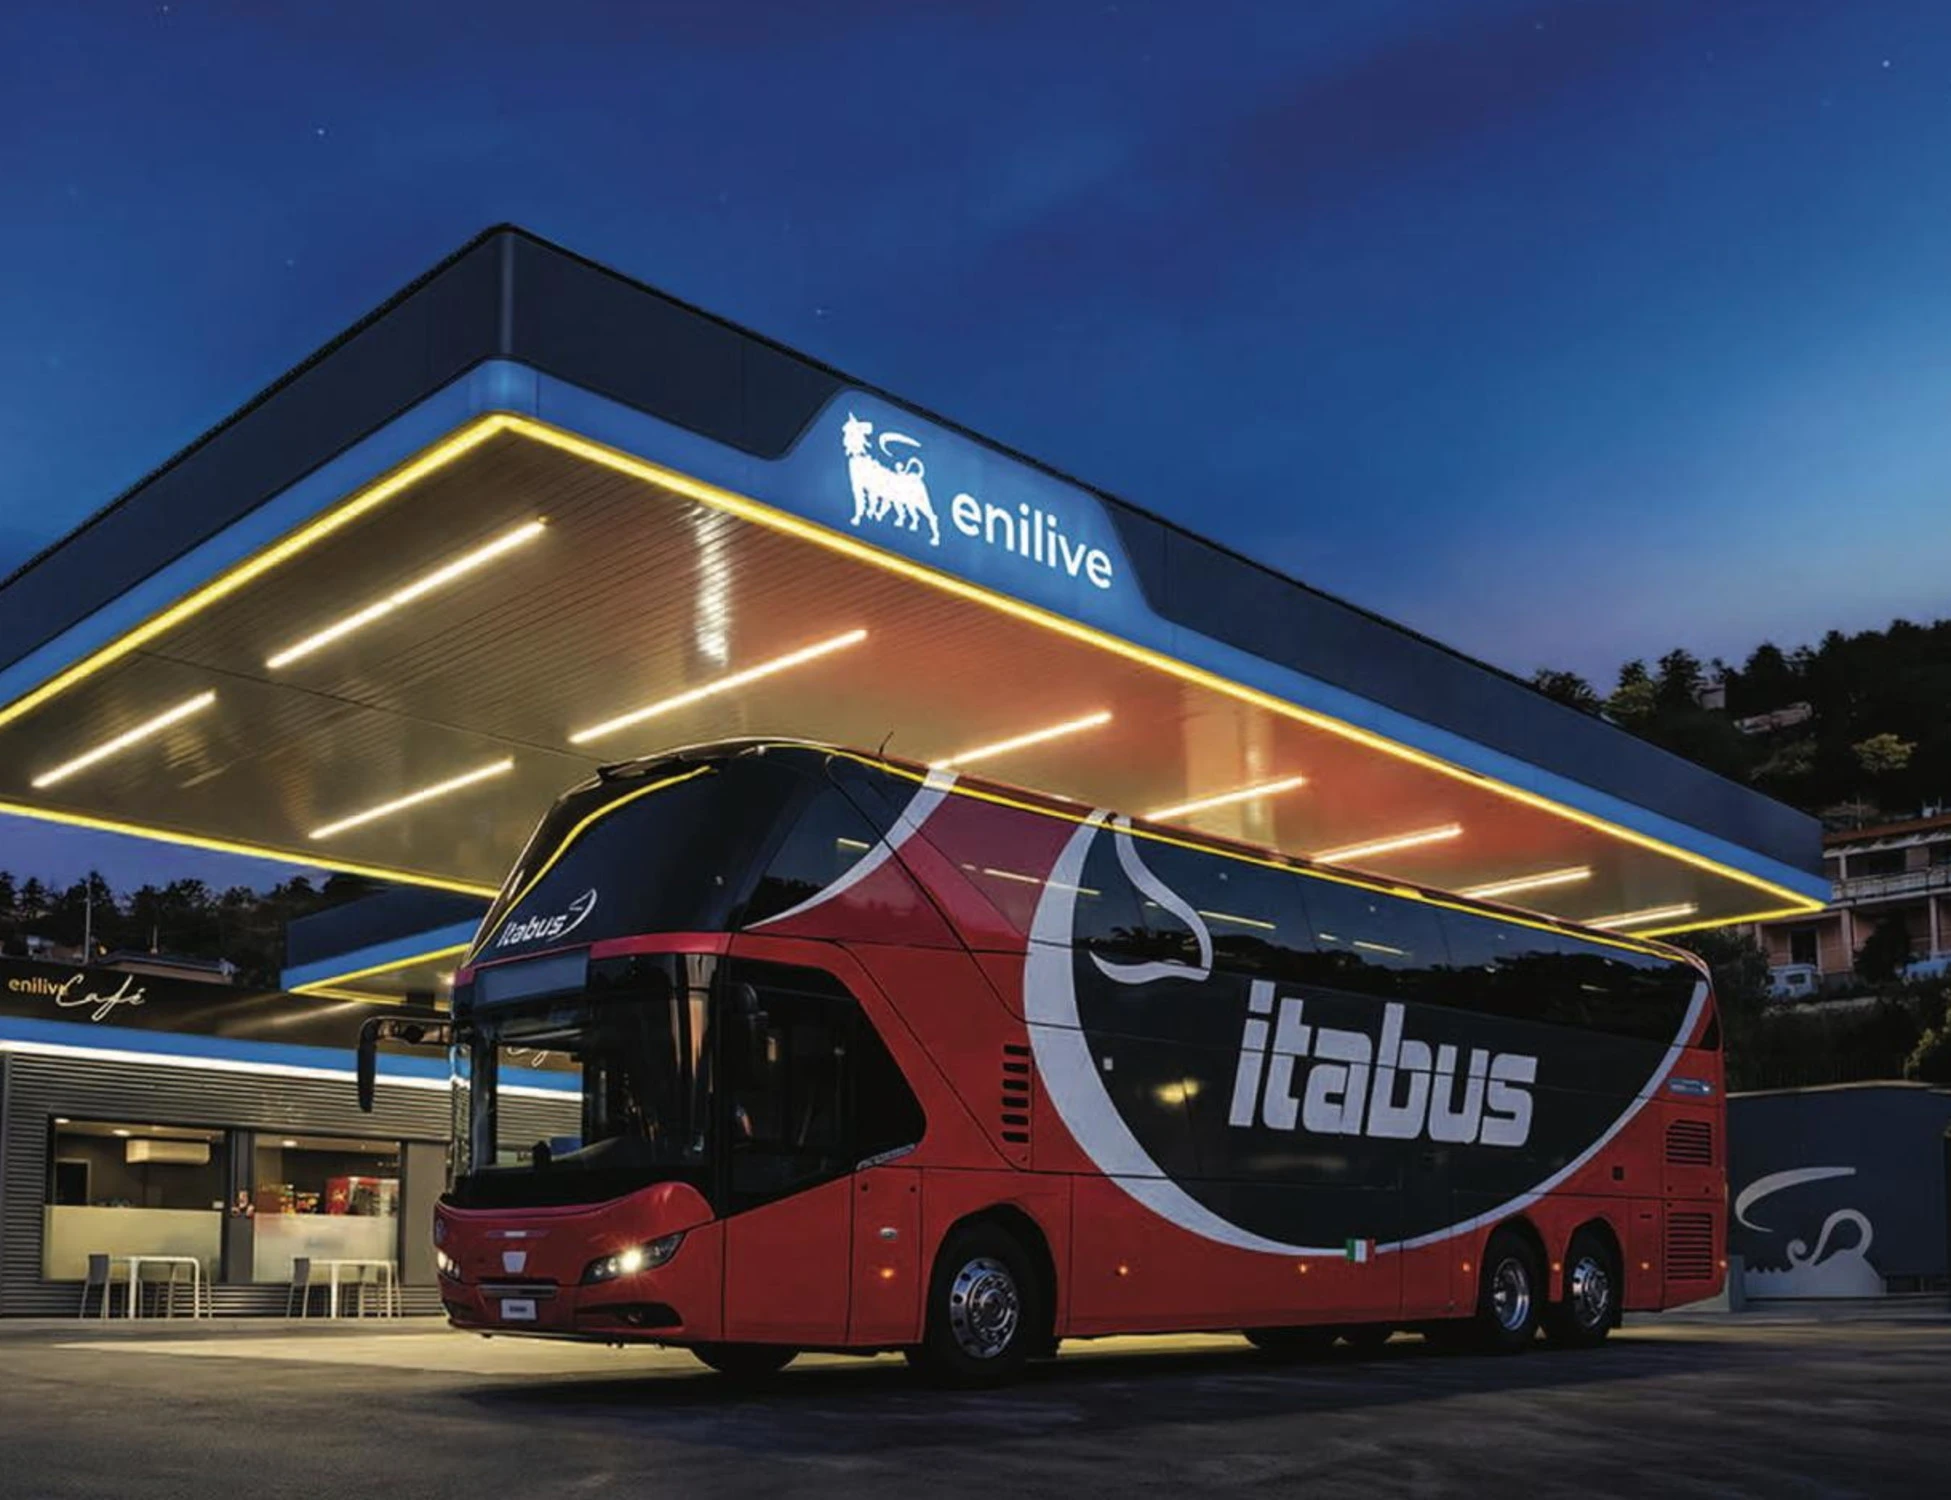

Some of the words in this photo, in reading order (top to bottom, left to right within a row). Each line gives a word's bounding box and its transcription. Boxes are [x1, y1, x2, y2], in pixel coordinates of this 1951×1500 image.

[952, 493, 1113, 589] enilive
[496, 915, 568, 948] itabus
[56, 973, 146, 1021] Café
[1229, 979, 1538, 1147] itabus
